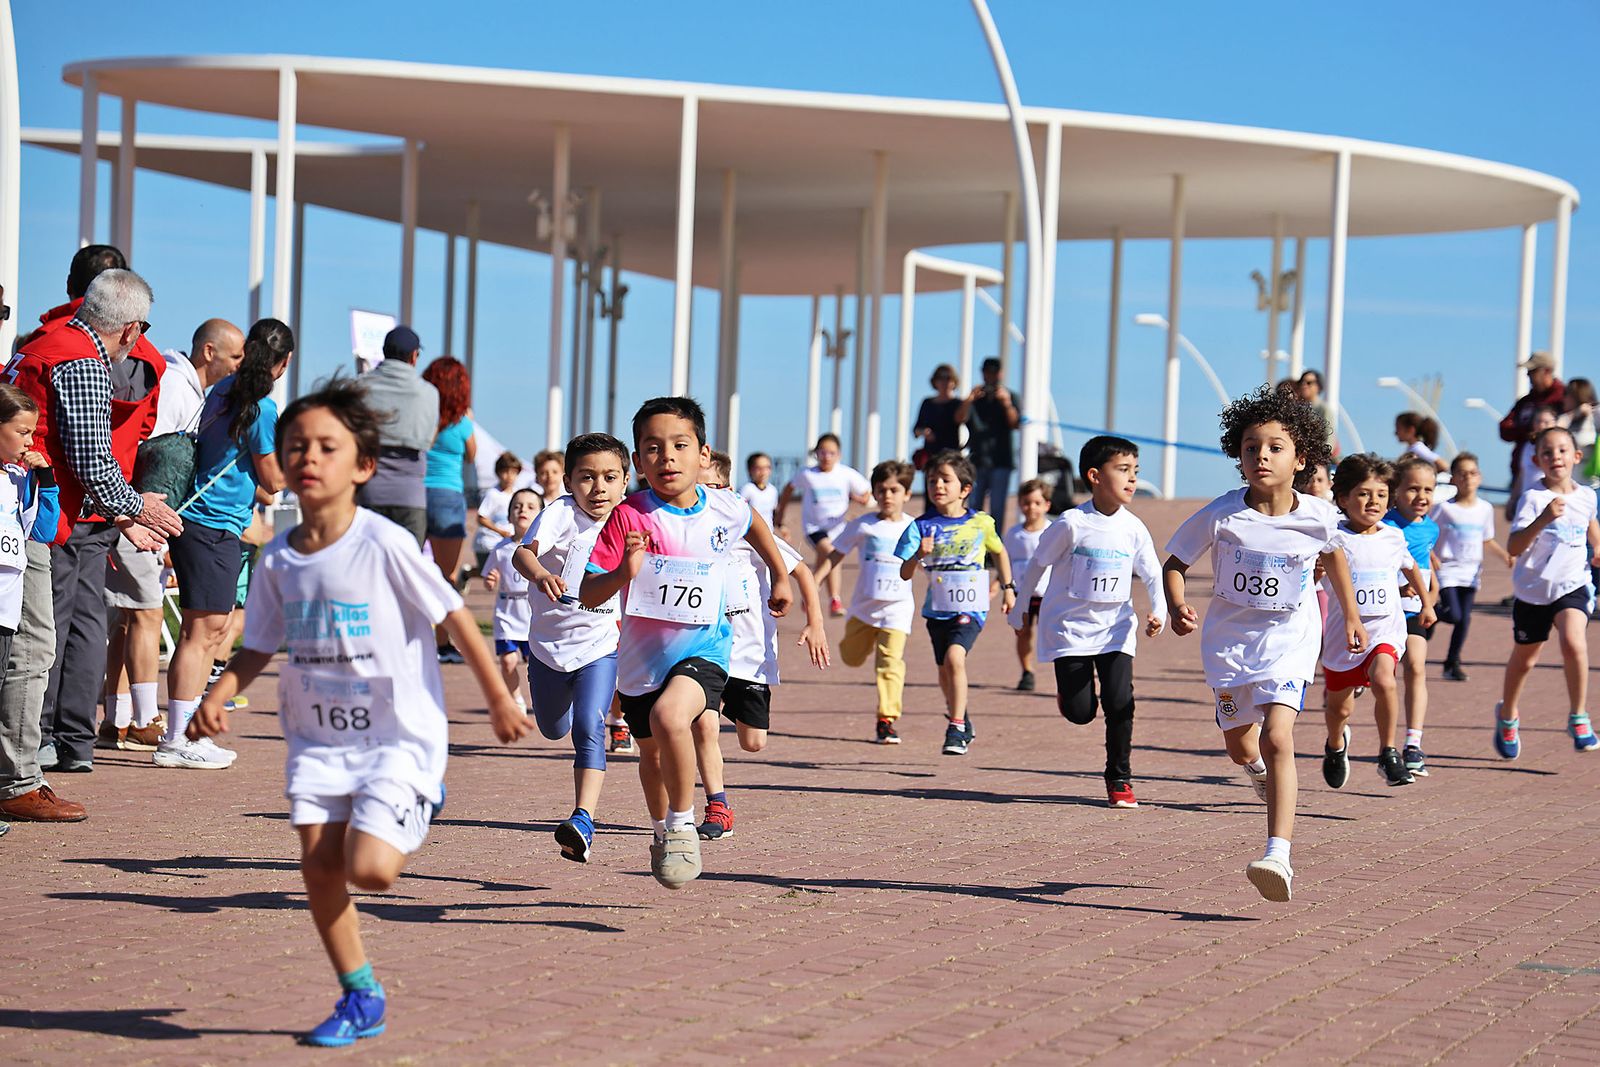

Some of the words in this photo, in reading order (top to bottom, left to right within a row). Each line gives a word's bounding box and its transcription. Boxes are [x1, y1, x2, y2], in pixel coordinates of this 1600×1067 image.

[877, 578, 900, 592] 175
[1091, 576, 1120, 592] 117
[1233, 571, 1280, 597] 038
[658, 583, 704, 609] 176
[947, 588, 977, 603] 100
[1355, 587, 1388, 606] 019
[331, 606, 369, 623] kilos
[347, 624, 371, 637] km
[310, 704, 371, 732] 168
